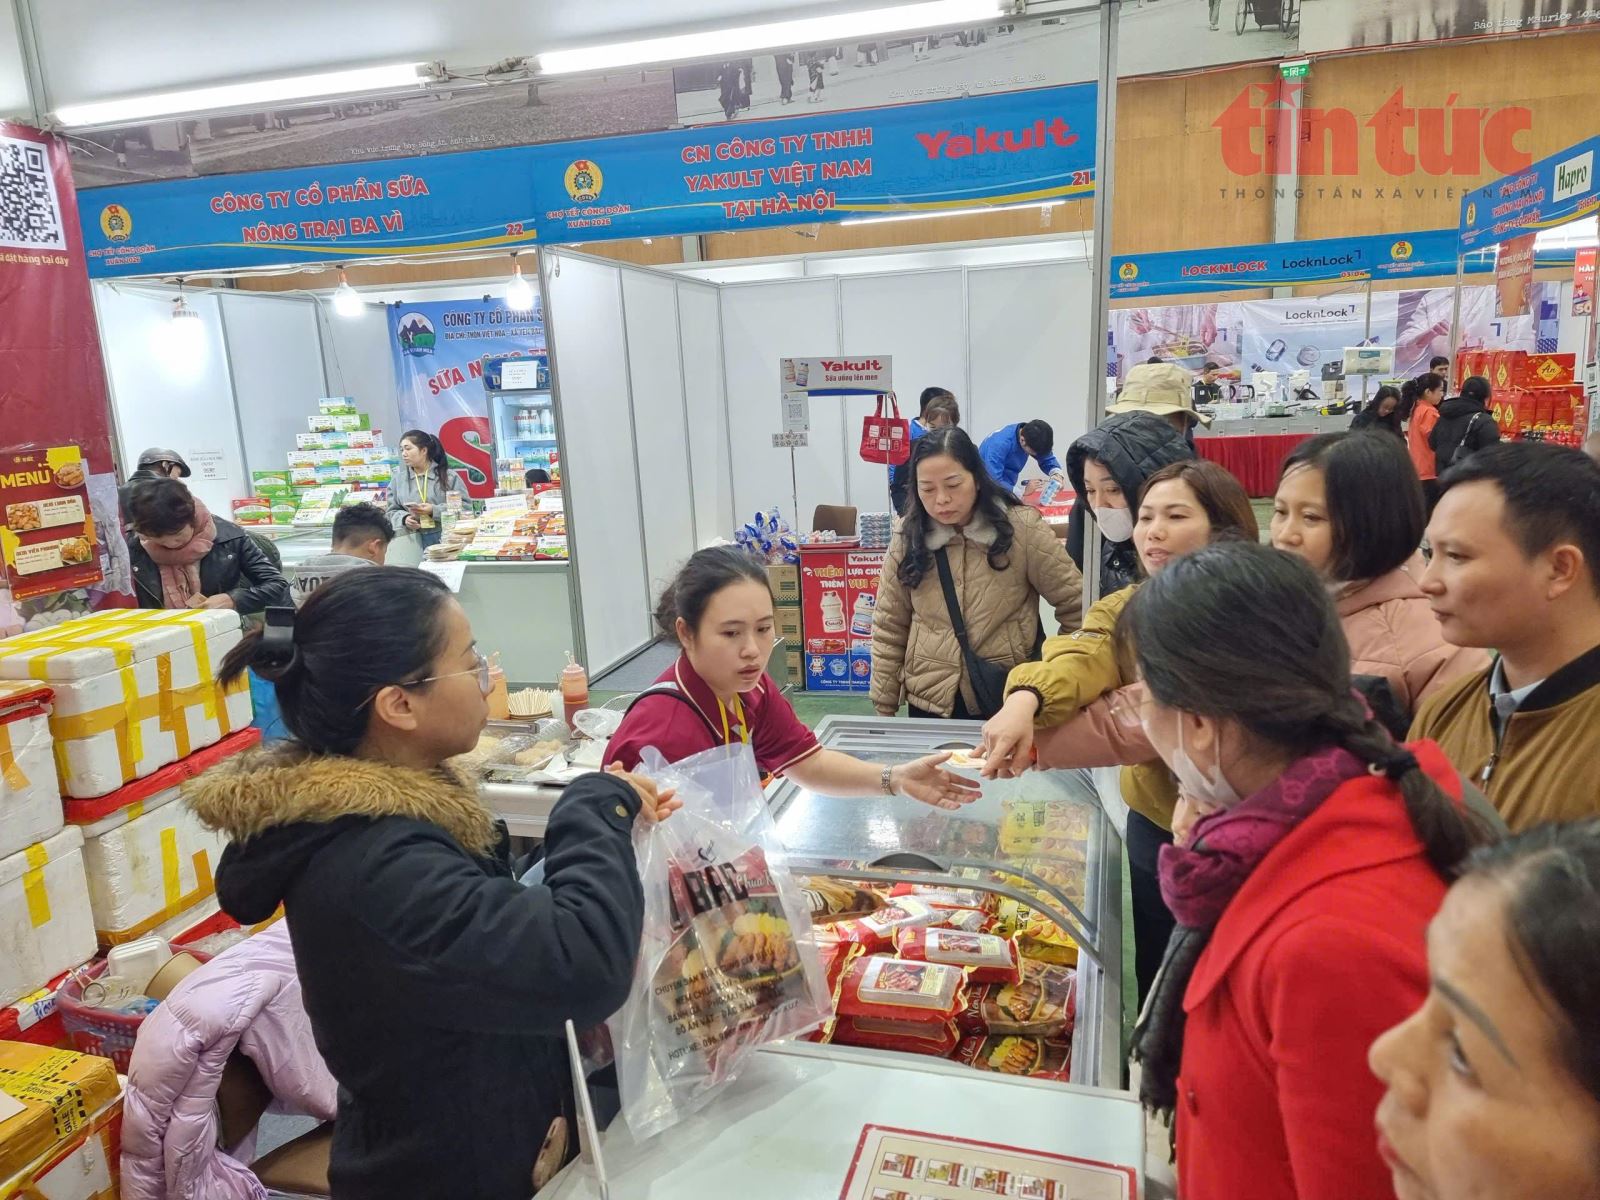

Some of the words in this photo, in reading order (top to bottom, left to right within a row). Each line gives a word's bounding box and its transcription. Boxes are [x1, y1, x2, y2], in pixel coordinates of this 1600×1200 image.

[1527, 12, 1573, 25] Maurice
[681, 143, 713, 164] CN
[716, 134, 775, 161] CÔNG
[783, 133, 808, 155] TY
[810, 127, 873, 151] TNHH
[915, 116, 1081, 161] Yakult
[684, 168, 767, 193] YAKULT
[768, 161, 817, 190] VIỆT
[820, 157, 872, 179] NAM
[1071, 171, 1091, 187] 21
[1557, 165, 1587, 194] Hapro
[210, 188, 265, 214] CÔNG
[266, 191, 291, 212] TY
[294, 181, 323, 206] CỔ
[327, 176, 384, 204] PHẦN
[386, 174, 430, 198] SỮA
[722, 199, 756, 221] TẠI
[760, 190, 791, 216] HÀ
[795, 189, 835, 214] NỘI
[242, 215, 297, 243] NÔNG
[300, 218, 348, 242] TRẠI
[351, 214, 380, 235] BA
[381, 210, 404, 233] VÌ
[505, 223, 524, 237] 22
[568, 218, 590, 228] XUÂN
[1181, 261, 1268, 277] LOCKNLOCK
[1282, 253, 1354, 269] LocknLock
[443, 306, 471, 327] CÔNG
[474, 311, 486, 324] TY
[489, 304, 503, 324] CỔ
[1285, 307, 1348, 321] LocknLock
[821, 359, 883, 372] Yakult
[428, 365, 466, 396] SỮA
[0, 469, 50, 489] MENU
[814, 564, 844, 578] THÊM
[820, 579, 844, 588] THÊM
[848, 578, 868, 589] VUI
